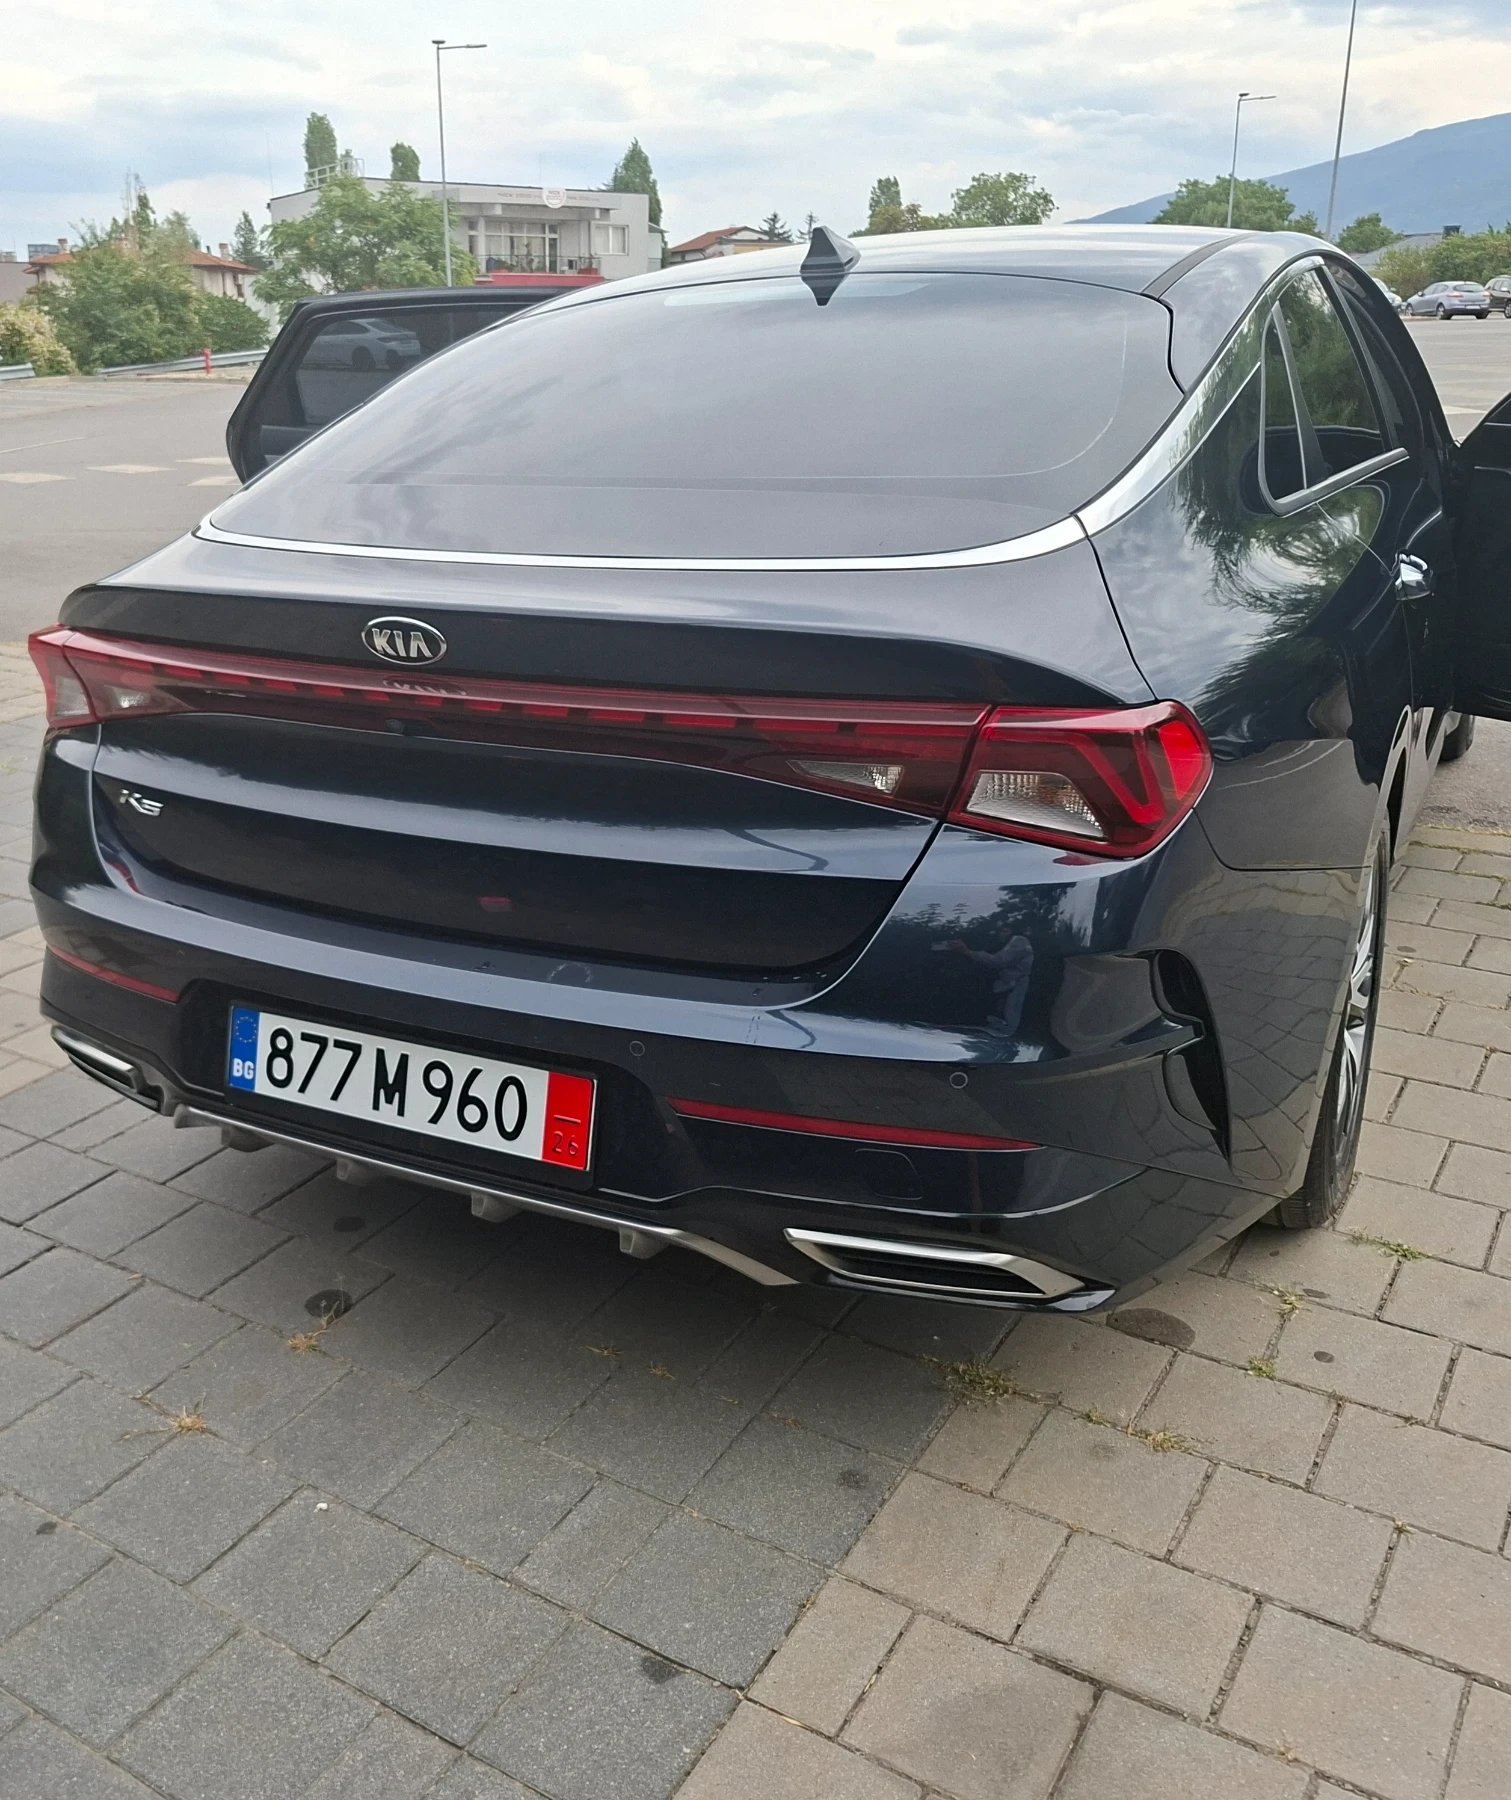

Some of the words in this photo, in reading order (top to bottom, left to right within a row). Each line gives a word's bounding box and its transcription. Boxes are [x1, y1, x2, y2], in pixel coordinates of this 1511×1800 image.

[371, 628, 434, 658] KIA
[120, 789, 164, 816] K5
[233, 1057, 254, 1080] BG
[266, 1027, 362, 1102] 877
[372, 1047, 410, 1118] M
[422, 1060, 528, 1141] 960
[552, 1130, 579, 1156] 26
